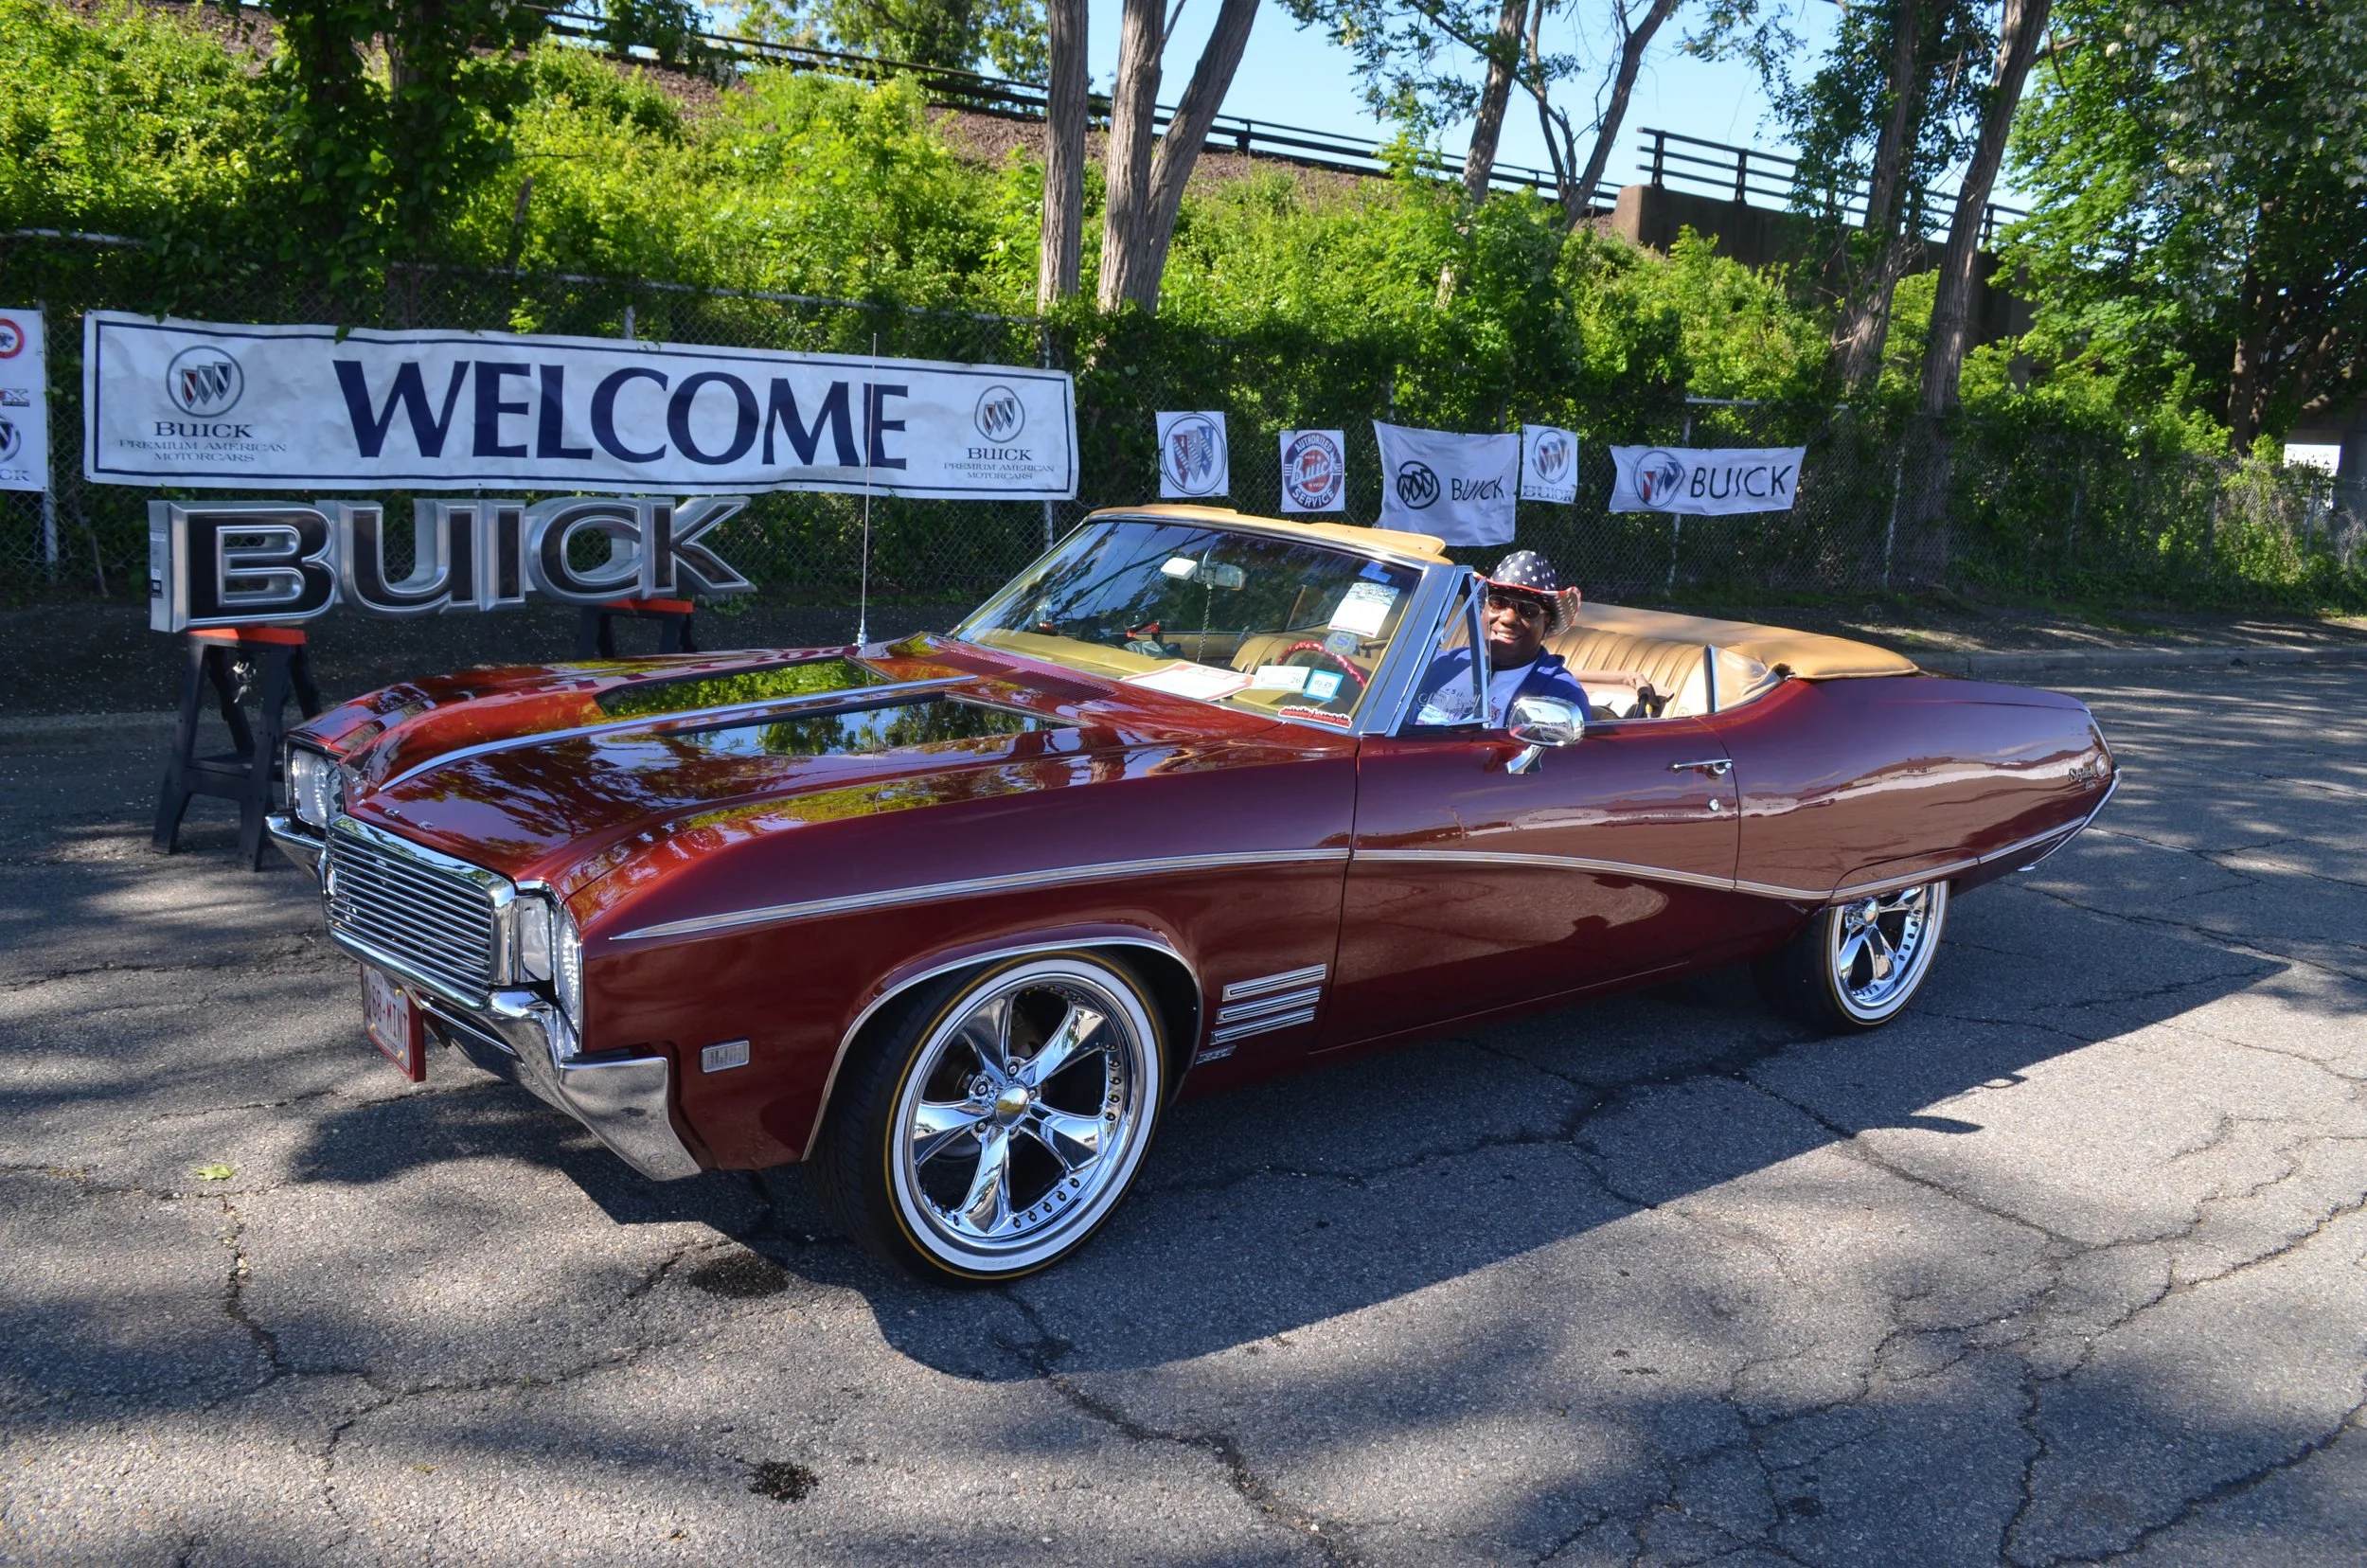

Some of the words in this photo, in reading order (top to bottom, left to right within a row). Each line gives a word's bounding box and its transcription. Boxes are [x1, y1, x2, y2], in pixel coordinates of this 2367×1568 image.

[333, 360, 908, 471] WELCOME
[153, 421, 254, 438] BUICK
[119, 439, 198, 451] PREMIUM
[204, 442, 288, 452] AMERICAN
[1294, 435, 1334, 453] AUTHORIZED
[154, 453, 256, 462] MOTORCARS
[967, 447, 1033, 461] BUICK
[943, 462, 996, 471] PREMIUM
[999, 464, 1055, 472] AMERICAN
[1290, 451, 1336, 487] Buick
[967, 472, 1033, 480] MOTORCARS
[1690, 465, 1793, 498] BUICK
[1451, 475, 1504, 501] BUICK
[1522, 485, 1574, 502] BUICK
[1291, 488, 1335, 508] SERVICE
[149, 497, 756, 633] BUICK
